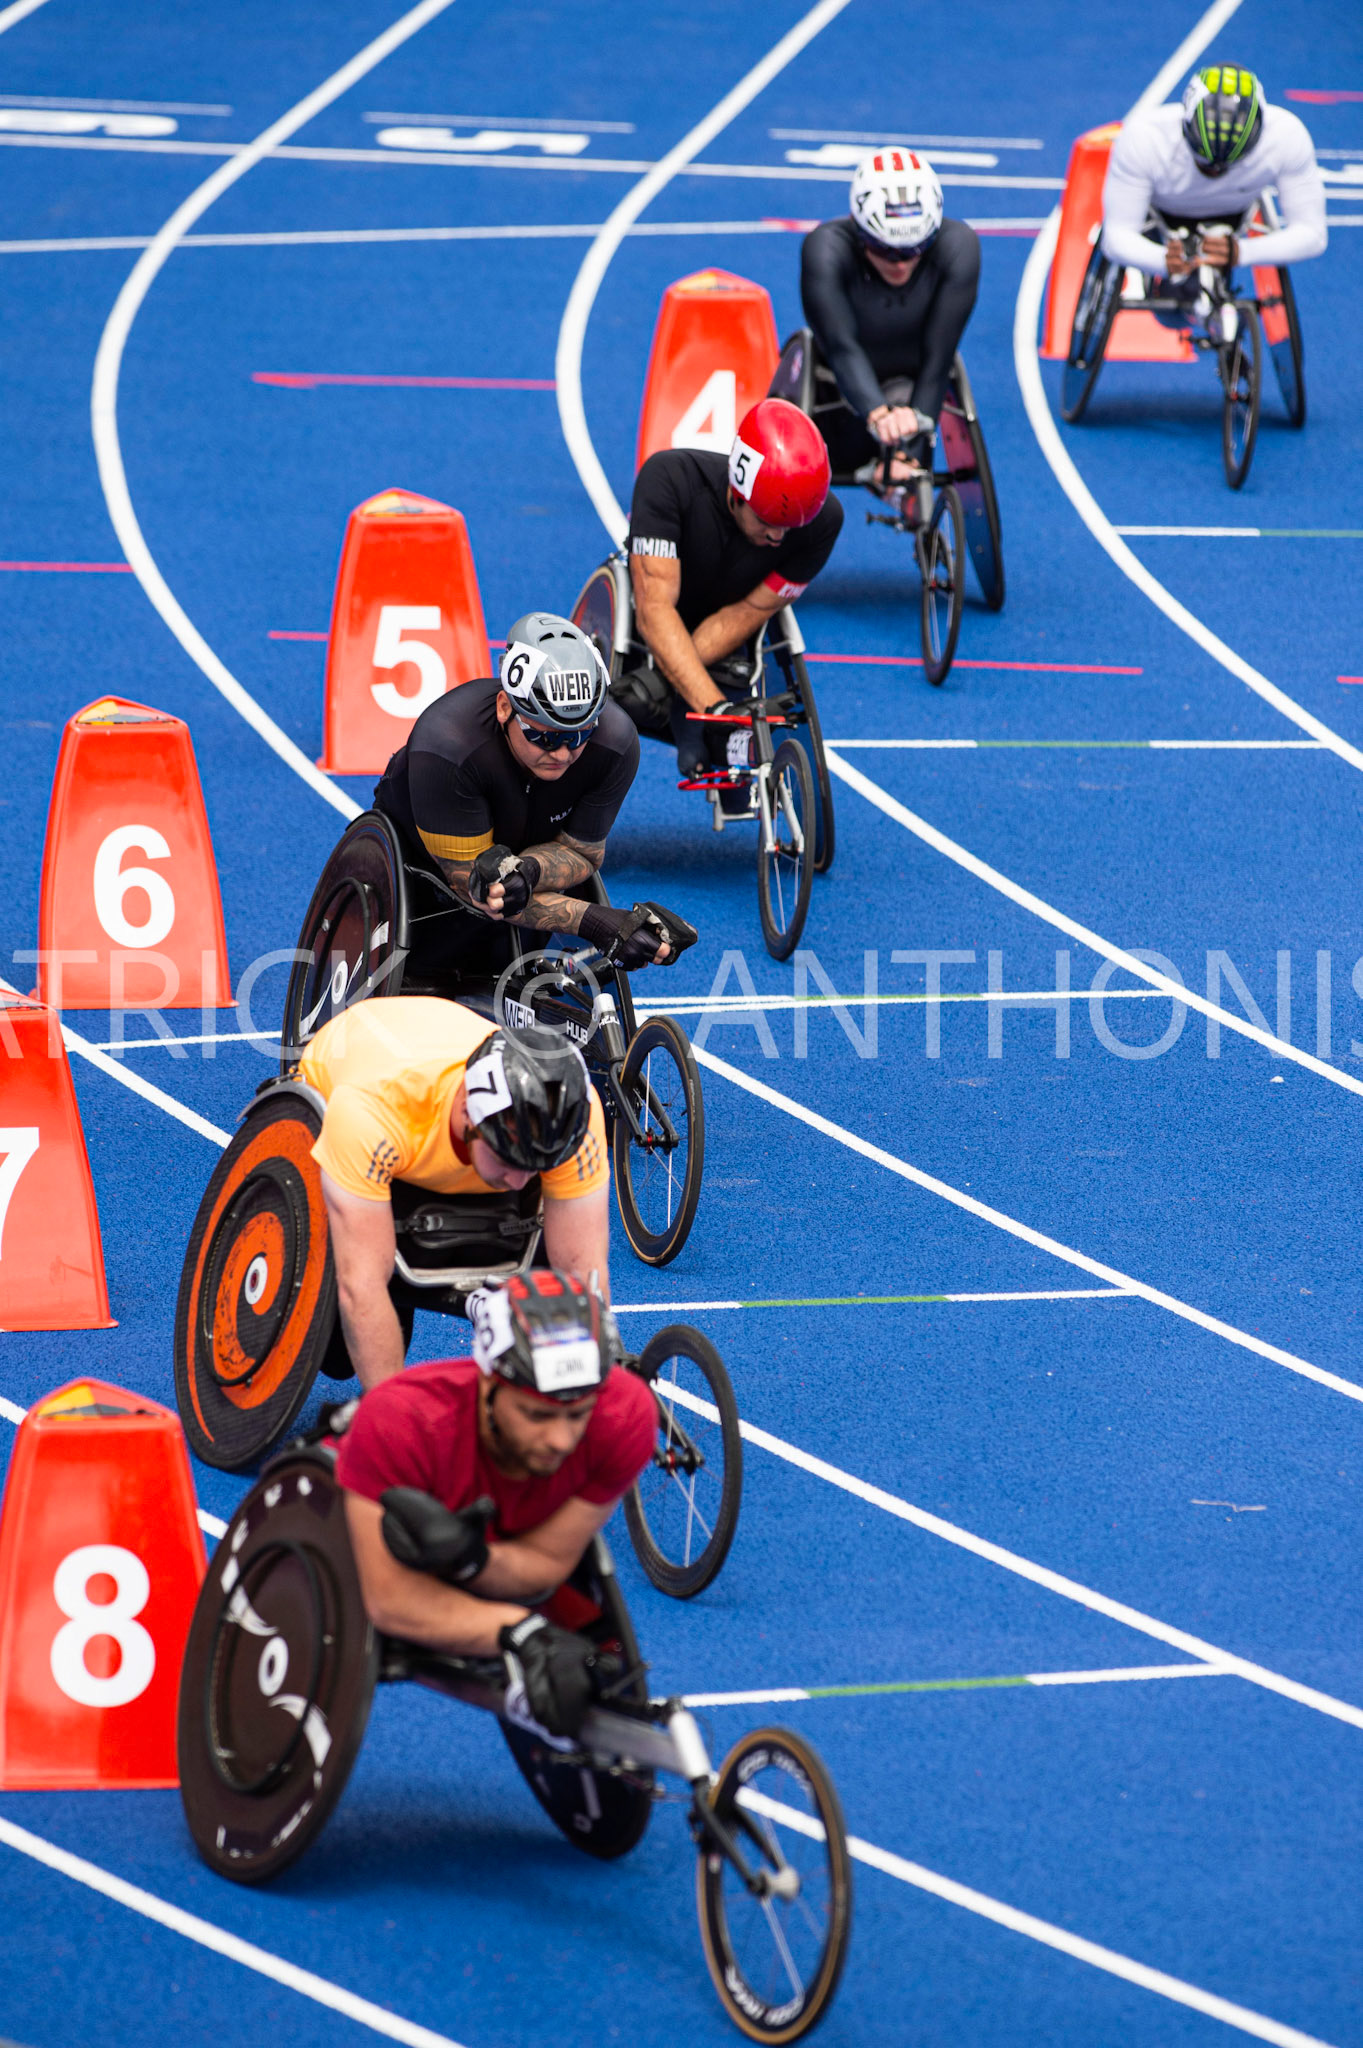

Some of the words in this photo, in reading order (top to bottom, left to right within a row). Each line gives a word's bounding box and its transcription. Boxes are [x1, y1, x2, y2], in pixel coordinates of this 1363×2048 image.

[376, 127, 590, 155] 5
[672, 370, 736, 451] 4
[733, 452, 751, 486] 5
[632, 536, 678, 559] KYMIRA
[370, 605, 447, 718] 5
[507, 652, 530, 688] 6
[548, 671, 592, 702] WEIR
[93, 824, 176, 948] 6
[468, 1070, 498, 1095] 7
[50, 1544, 156, 1708] 8
